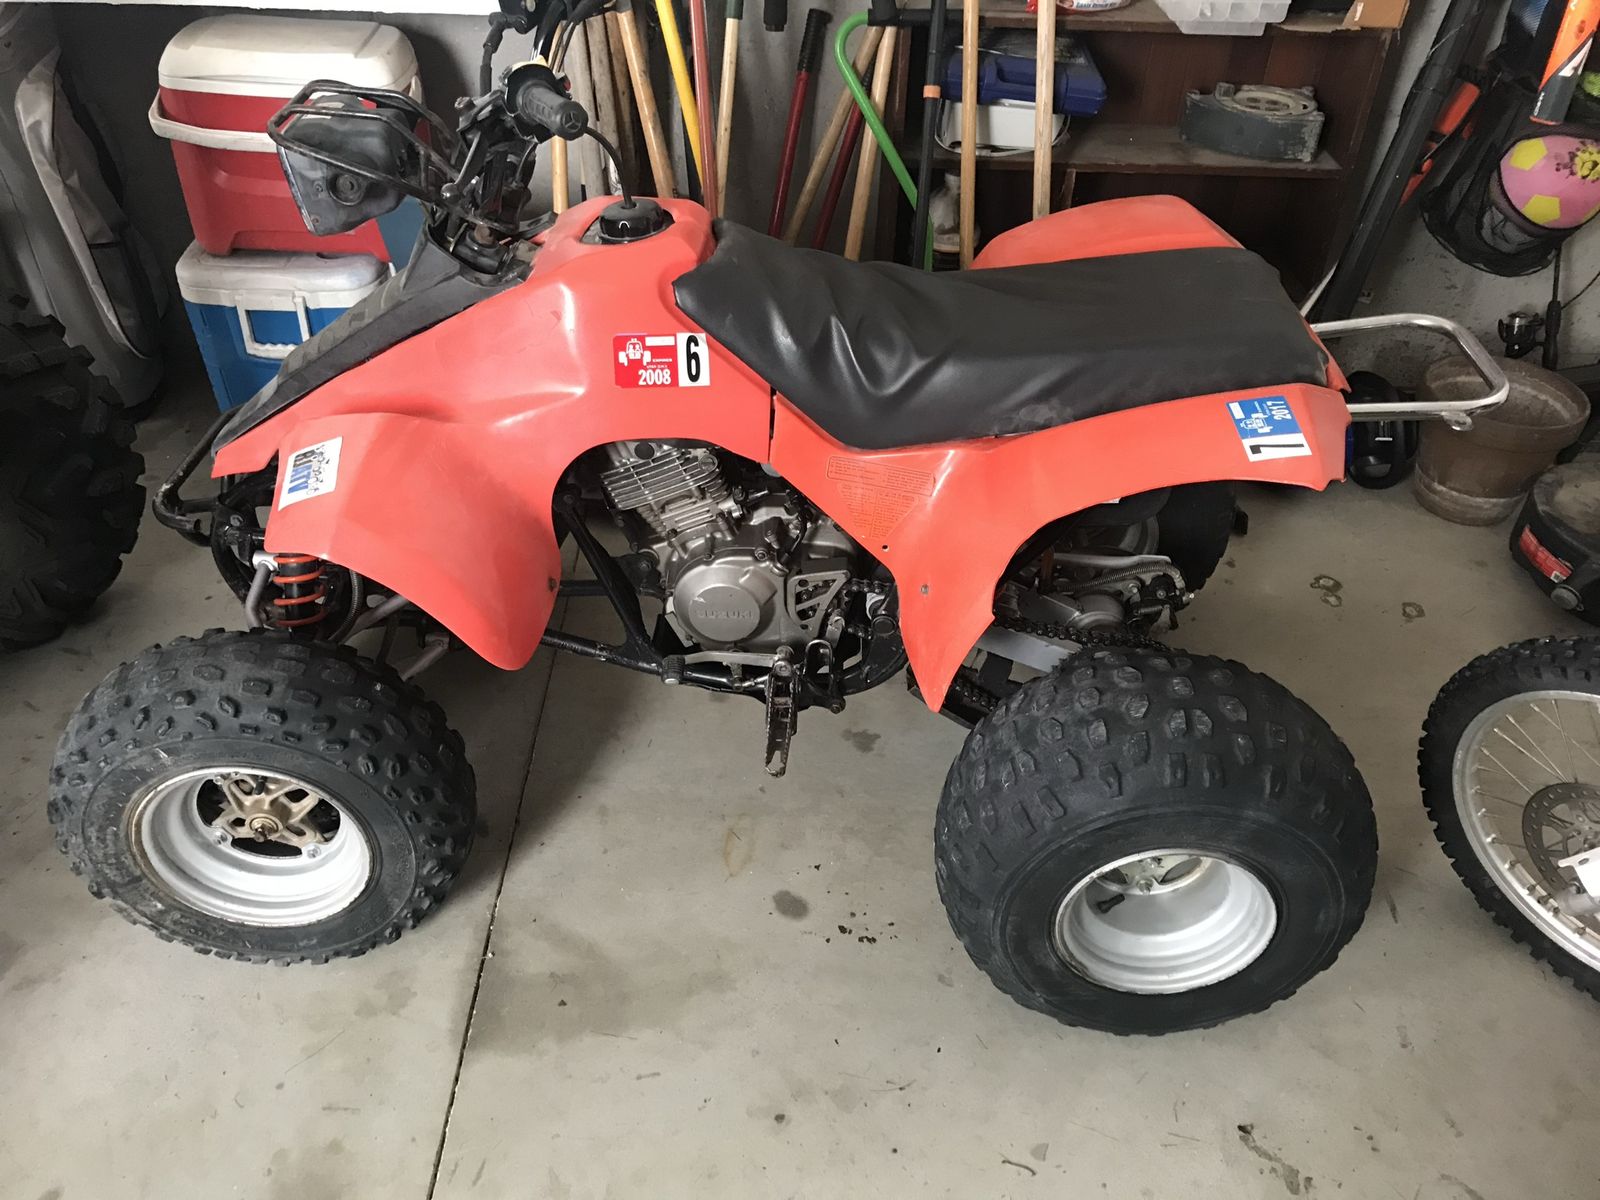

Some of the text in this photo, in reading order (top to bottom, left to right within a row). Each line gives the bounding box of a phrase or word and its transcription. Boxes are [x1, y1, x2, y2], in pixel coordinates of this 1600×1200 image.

[685, 334, 701, 383] 6
[638, 369, 671, 386] 2008
[1266, 400, 1292, 421] 2017
[1249, 443, 1305, 455] 7
[695, 609, 752, 620] SUZUKI
